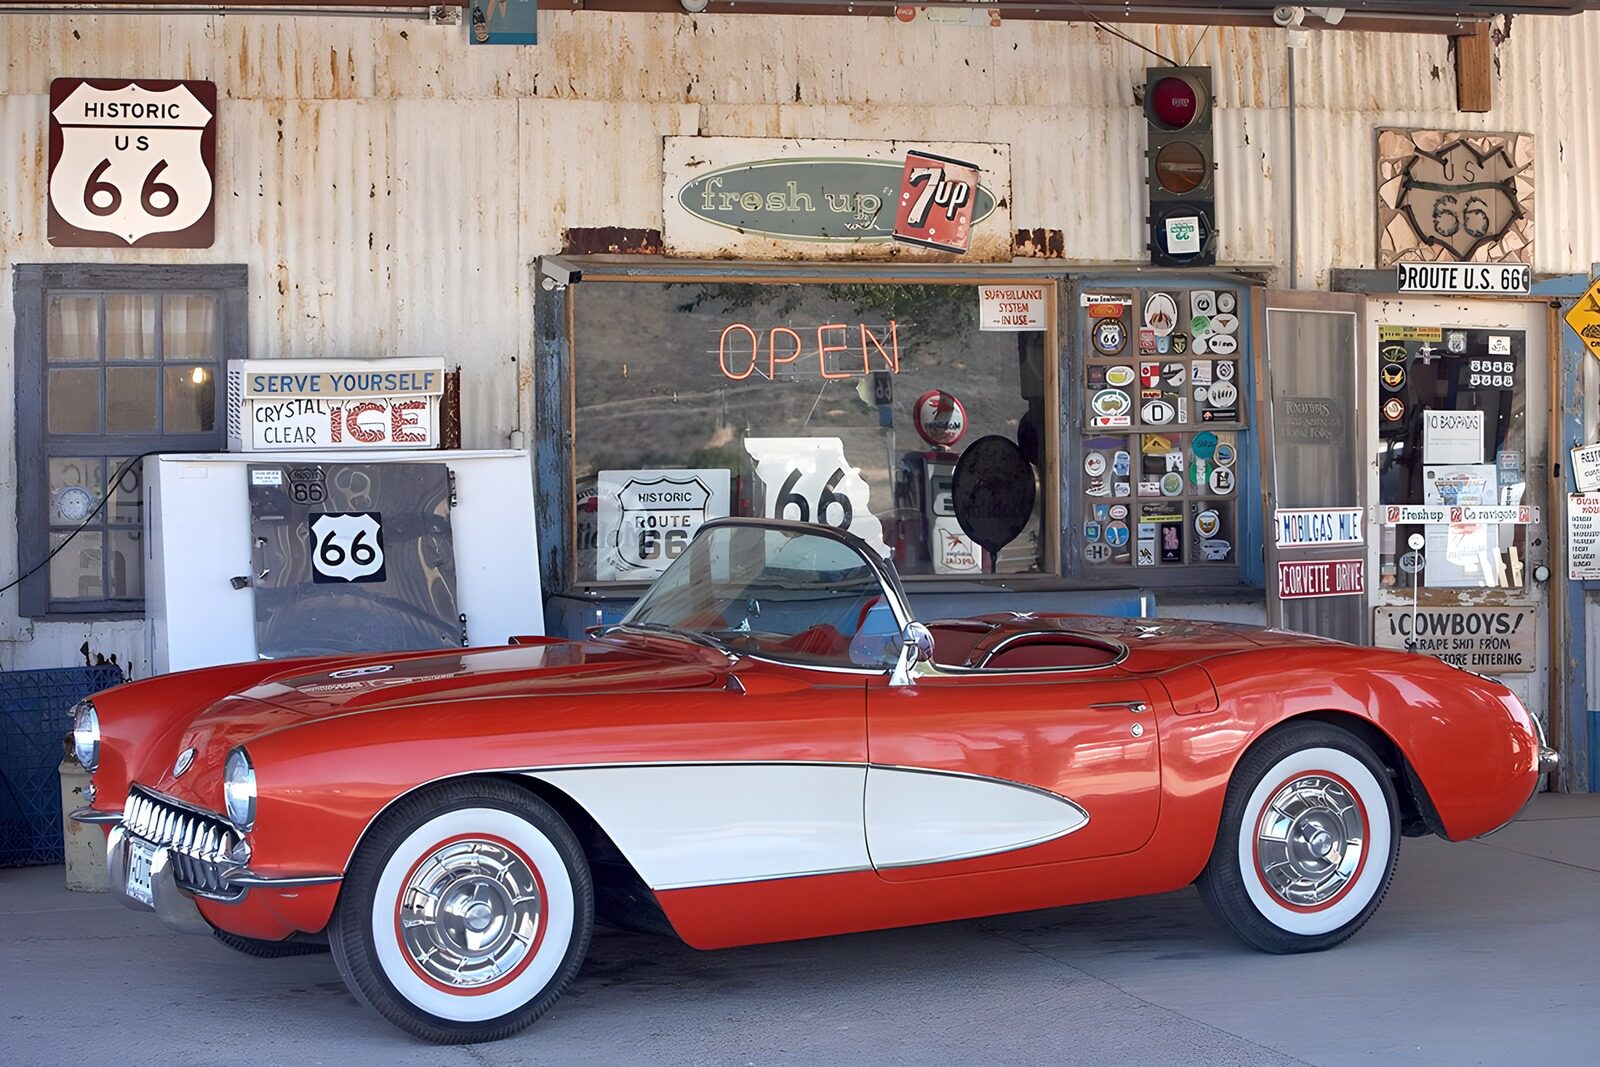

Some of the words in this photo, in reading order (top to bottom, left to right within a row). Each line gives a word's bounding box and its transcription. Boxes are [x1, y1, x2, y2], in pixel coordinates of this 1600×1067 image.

[84, 102, 180, 119] HISTORIC
[83, 158, 179, 217] 66
[1432, 195, 1489, 237] 66
[1408, 267, 1458, 289] ROUTE
[1463, 267, 1495, 290] U.S.
[1501, 269, 1520, 290] 66
[999, 303, 1029, 313] SYSTEM
[1012, 314, 1029, 326] USE
[1103, 333, 1117, 344] 66
[719, 320, 900, 381] OPEN
[253, 375, 321, 393] SERVE
[329, 372, 435, 392] YOURSELF
[255, 398, 327, 424] CRYSTAL
[330, 401, 427, 443] ICE
[263, 426, 317, 445] CLEAR
[294, 482, 323, 501] 66
[638, 492, 692, 503] HISTORIC
[774, 467, 853, 531] 66
[635, 514, 691, 528] ROUTE
[320, 529, 376, 567] 66
[637, 529, 689, 561] 66
[1282, 564, 1331, 594] CORVETTE
[1335, 563, 1361, 591] DRIVE
[1479, 637, 1511, 650] FROM
[1471, 653, 1522, 666] ENTERING
